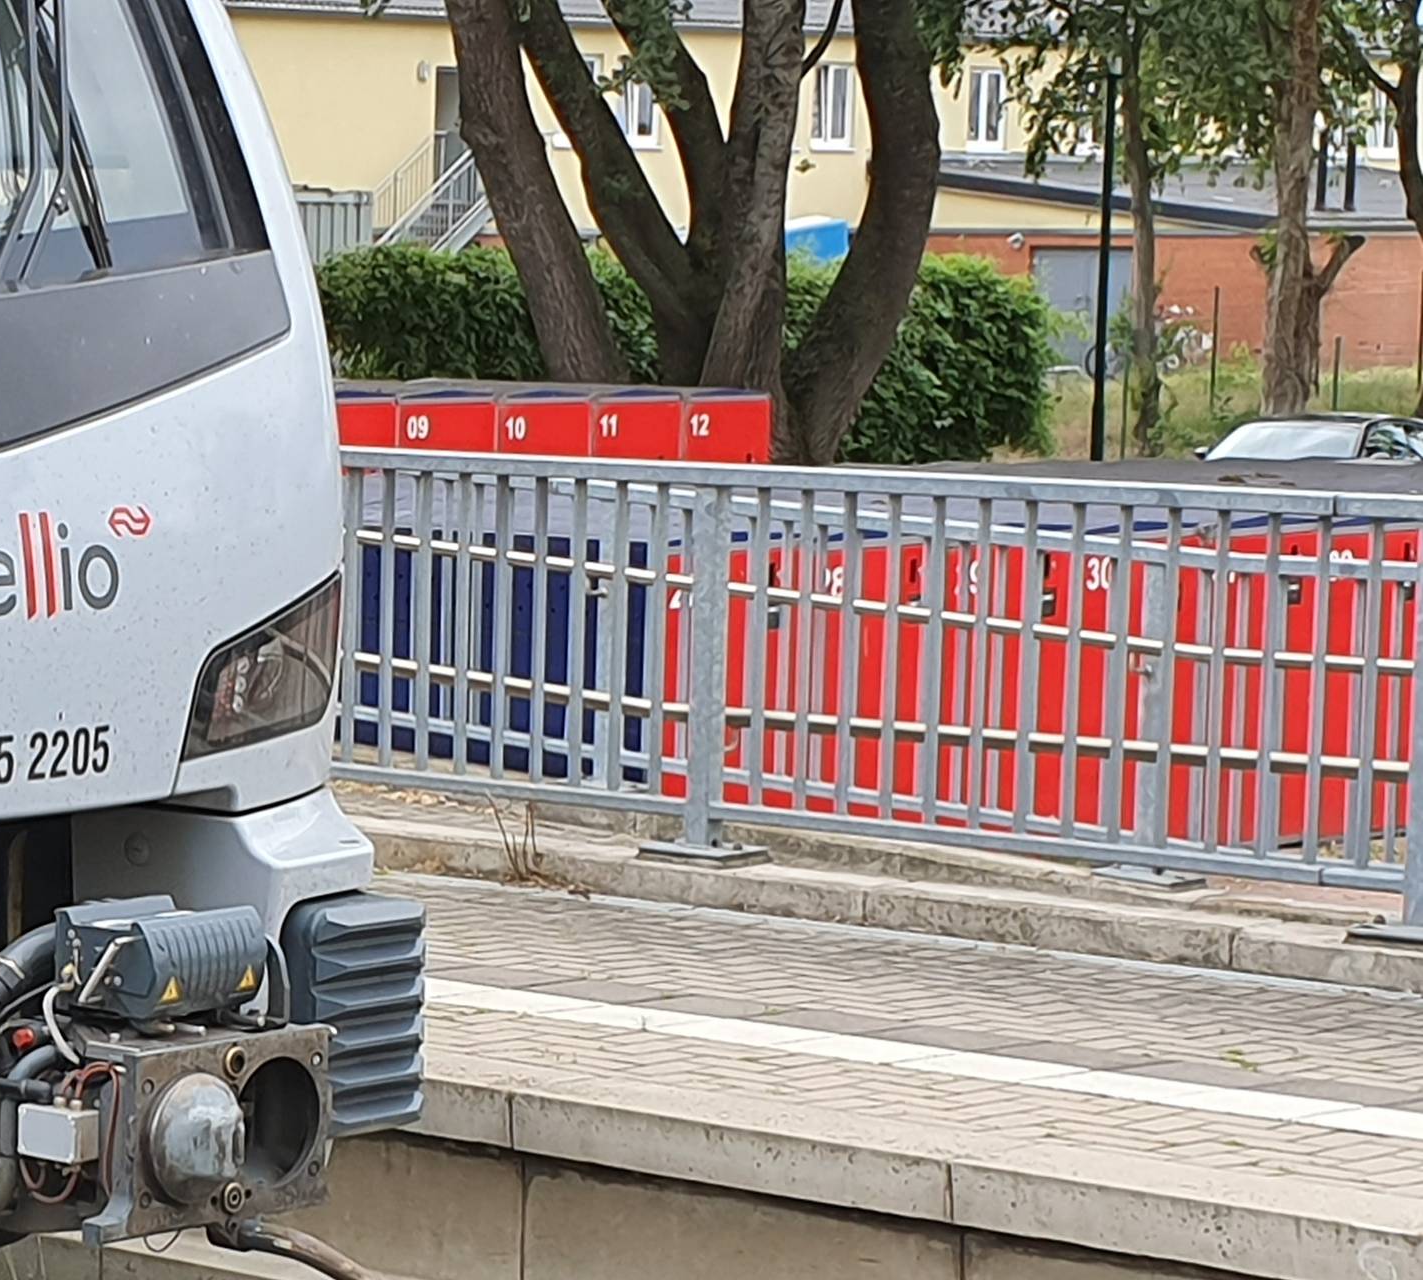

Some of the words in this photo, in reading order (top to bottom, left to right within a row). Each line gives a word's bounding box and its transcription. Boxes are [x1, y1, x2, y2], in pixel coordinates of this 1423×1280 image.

[406, 415, 429, 440] 09
[505, 417, 526, 440] 10
[599, 414, 618, 437] 11
[690, 414, 710, 437] 12
[823, 566, 844, 599] 8
[27, 725, 110, 780] 2205
